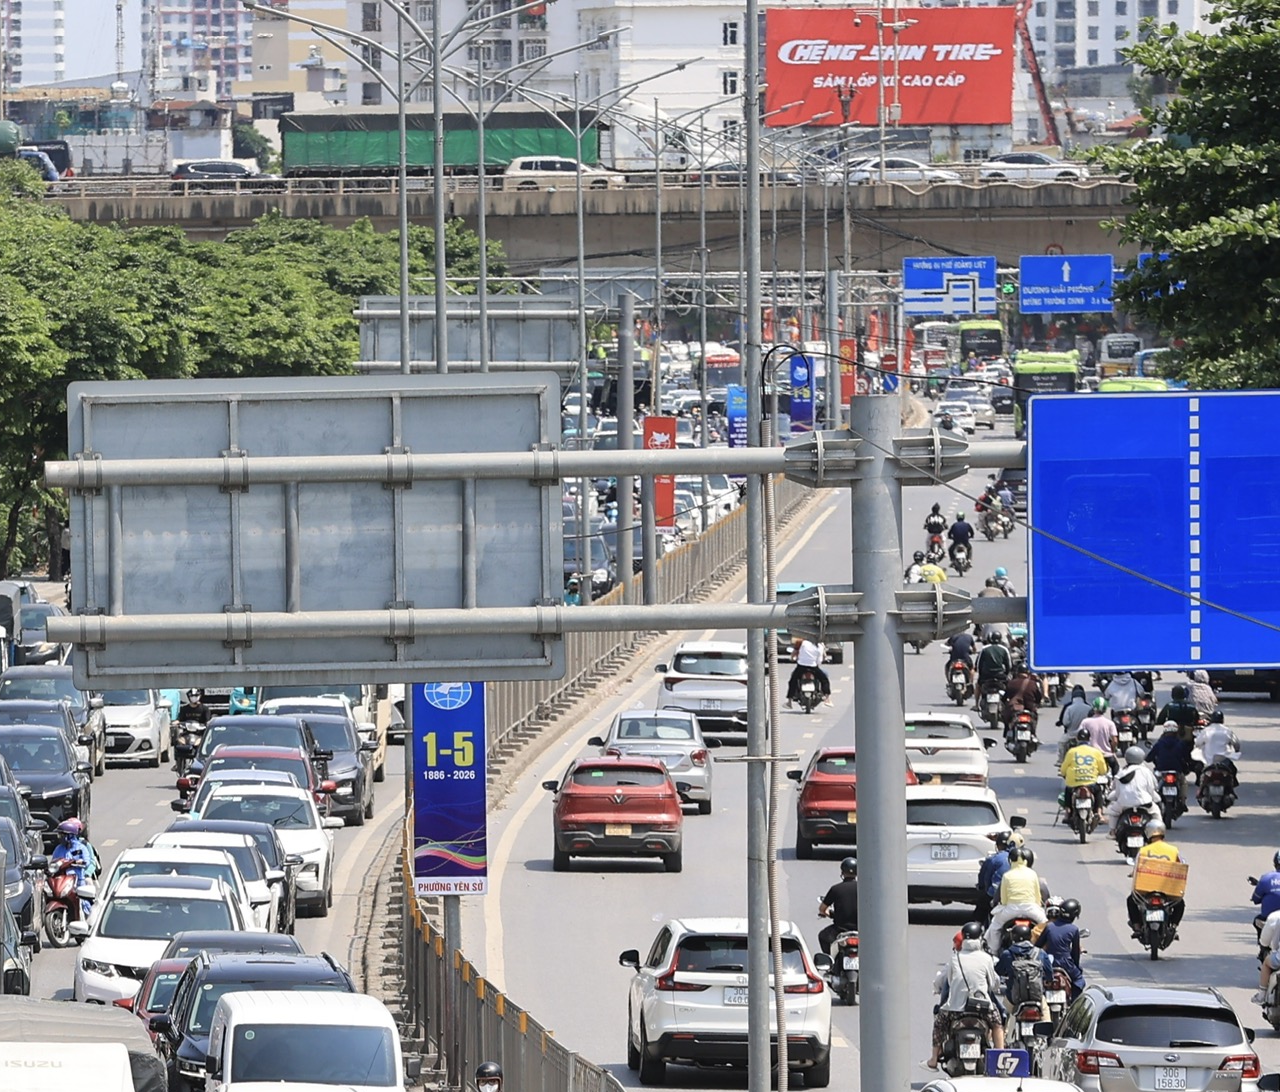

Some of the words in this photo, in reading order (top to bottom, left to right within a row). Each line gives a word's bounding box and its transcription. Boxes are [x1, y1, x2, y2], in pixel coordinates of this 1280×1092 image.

[778, 39, 866, 64] CHENG
[859, 44, 927, 61] SHIN
[932, 43, 1002, 61] TIRE
[848, 71, 877, 87] LỐP
[901, 75, 934, 87] CAO
[935, 70, 965, 87] CẤP
[1003, 284, 1015, 293] 25
[423, 732, 474, 767] 1-5
[1075, 752, 1094, 765] be
[423, 770, 445, 780] 1886
[453, 770, 475, 780] 2026
[418, 881, 452, 892] PHƯỜNG
[453, 880, 470, 892] YÊN
[471, 879, 484, 891] SỞ
[1162, 1068, 1179, 1078] 30G
[1157, 1079, 1186, 1088] 158.30
